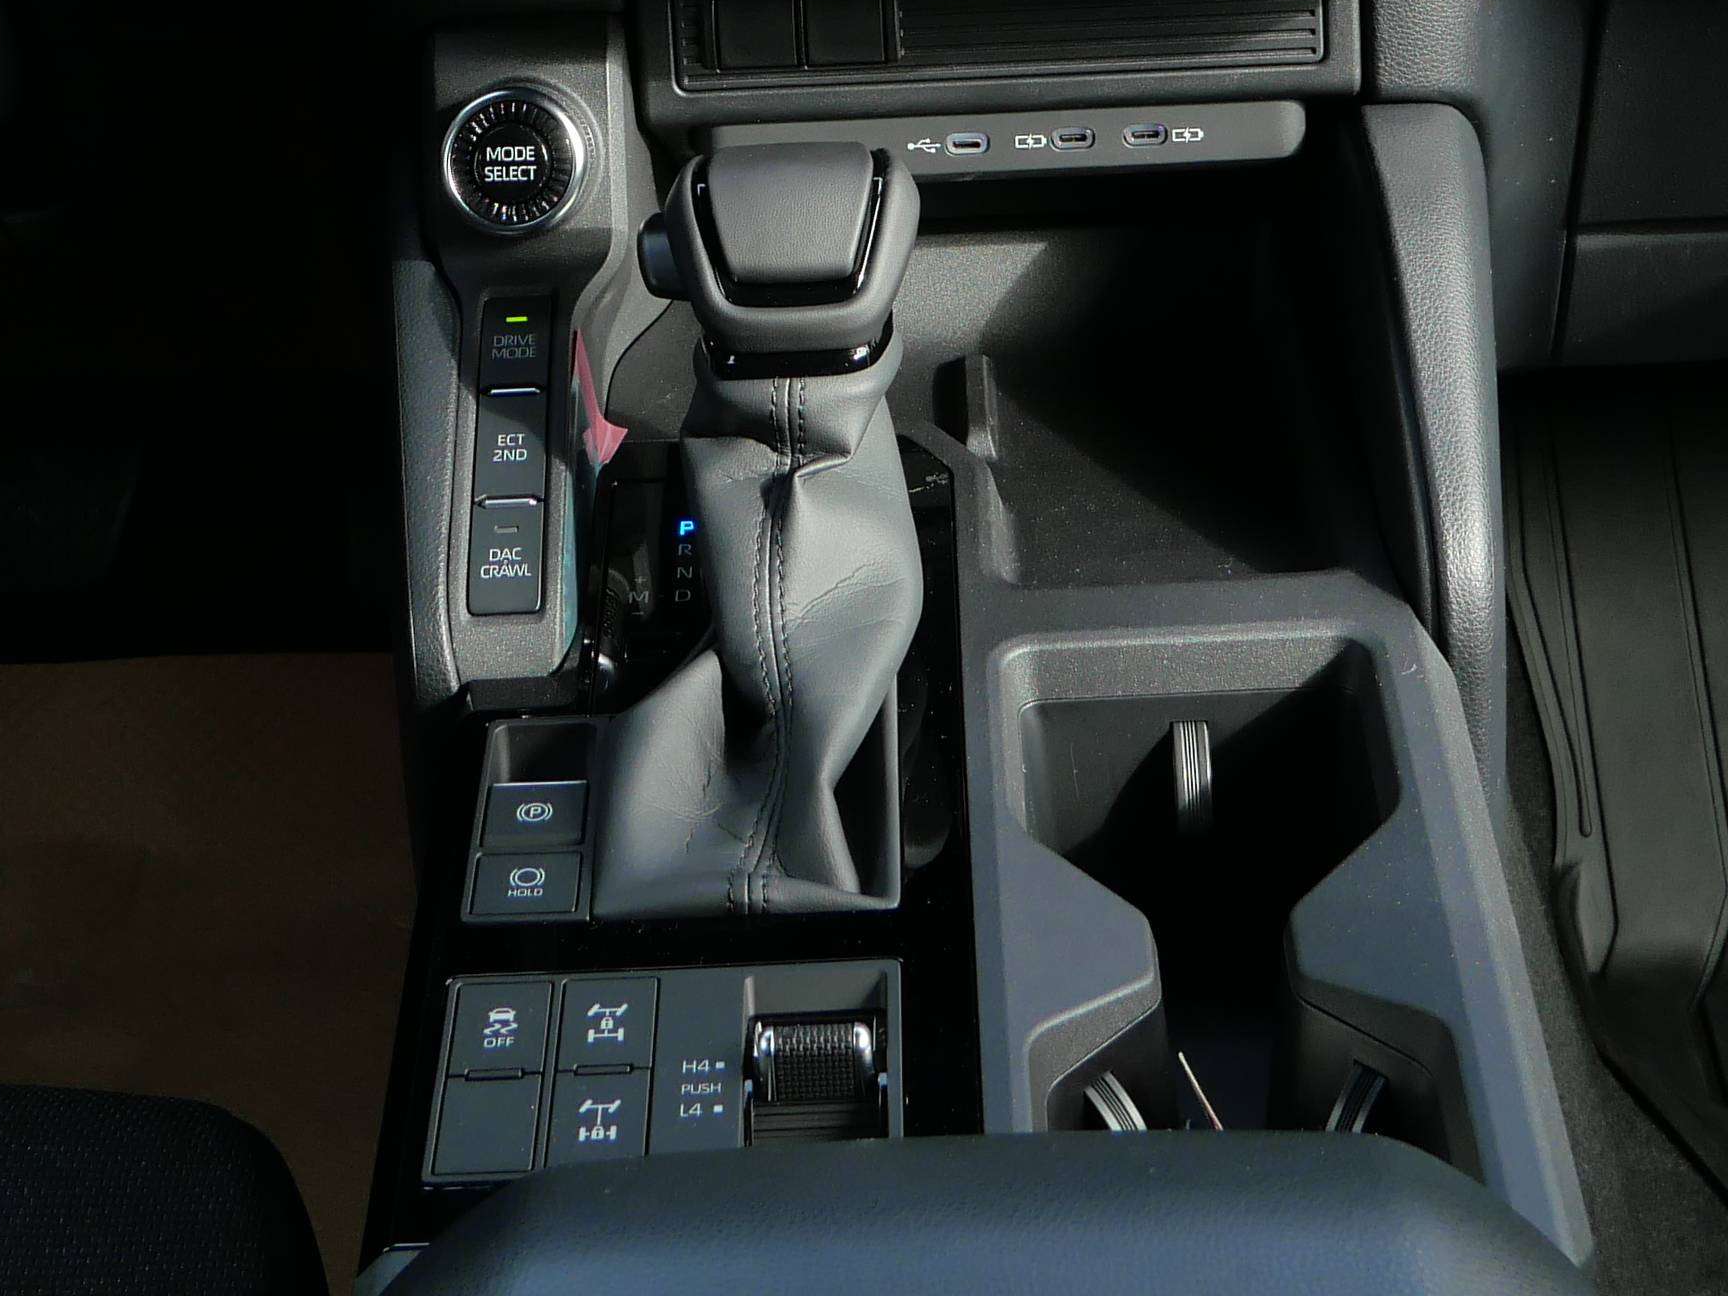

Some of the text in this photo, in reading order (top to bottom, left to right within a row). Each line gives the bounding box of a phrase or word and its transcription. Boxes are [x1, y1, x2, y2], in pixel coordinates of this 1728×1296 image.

[486, 146, 536, 162] MODE
[484, 165, 537, 182] SELECT
[493, 333, 536, 347] DRIVE
[491, 347, 537, 359] MODE
[497, 433, 525, 447] ECT
[492, 449, 528, 462] 2ND
[679, 520, 694, 536] P
[488, 547, 522, 562] DAC
[678, 543, 692, 556] R
[480, 563, 532, 579] CRAWL
[676, 565, 692, 579] N
[628, 590, 649, 604] M
[674, 589, 692, 602] D
[507, 888, 543, 897] HOLD
[483, 1036, 516, 1048] OFF
[682, 1059, 710, 1074] H4
[681, 1082, 722, 1095] PUSH
[679, 1102, 703, 1117] L4
